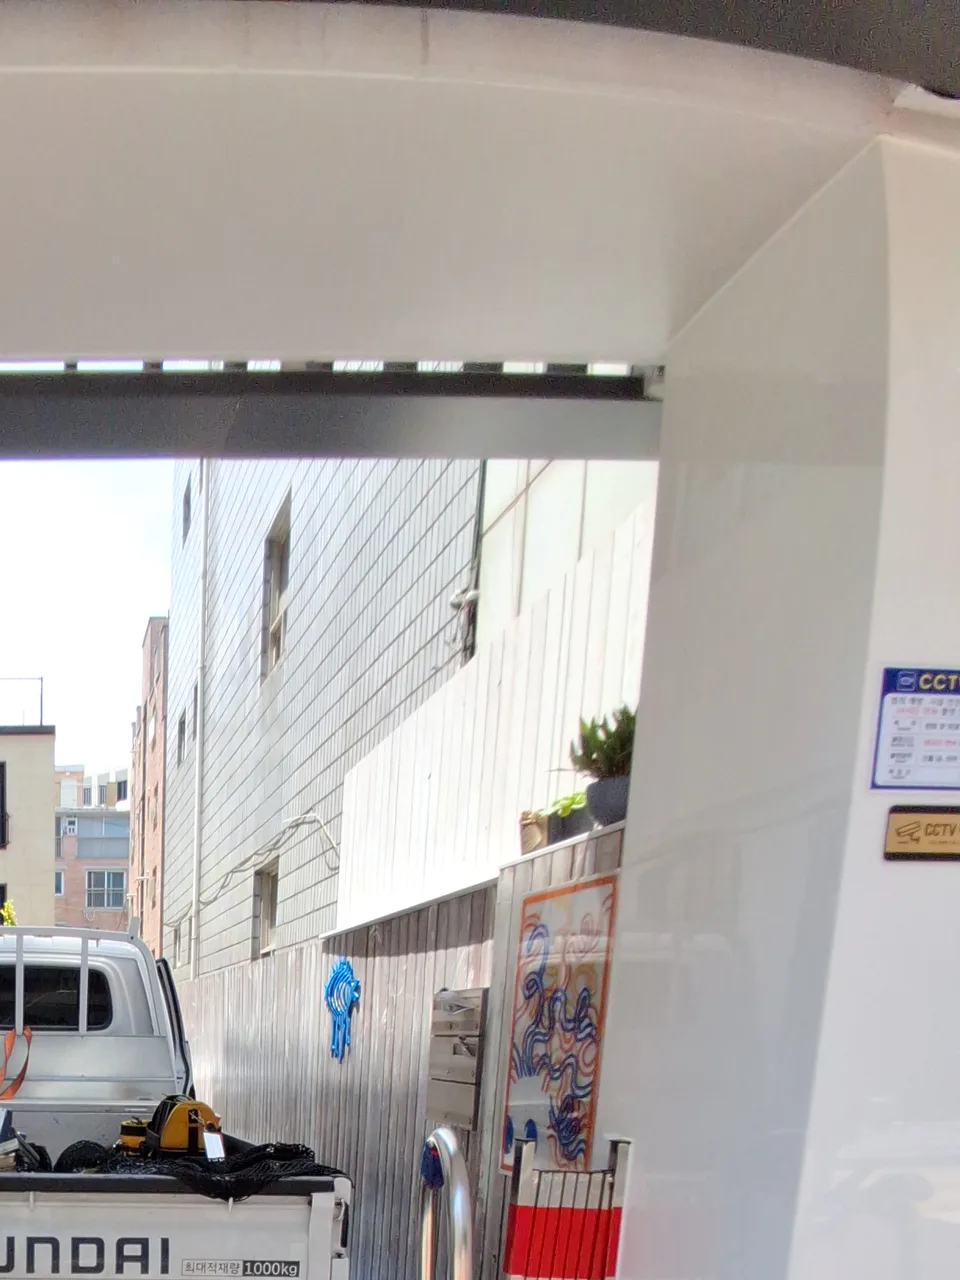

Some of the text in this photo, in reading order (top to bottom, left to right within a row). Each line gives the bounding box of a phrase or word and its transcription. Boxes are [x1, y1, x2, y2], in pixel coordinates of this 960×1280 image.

[919, 673, 960, 690] CCT
[925, 823, 957, 837] CCTV
[184, 1261, 241, 1275] 최대적재량
